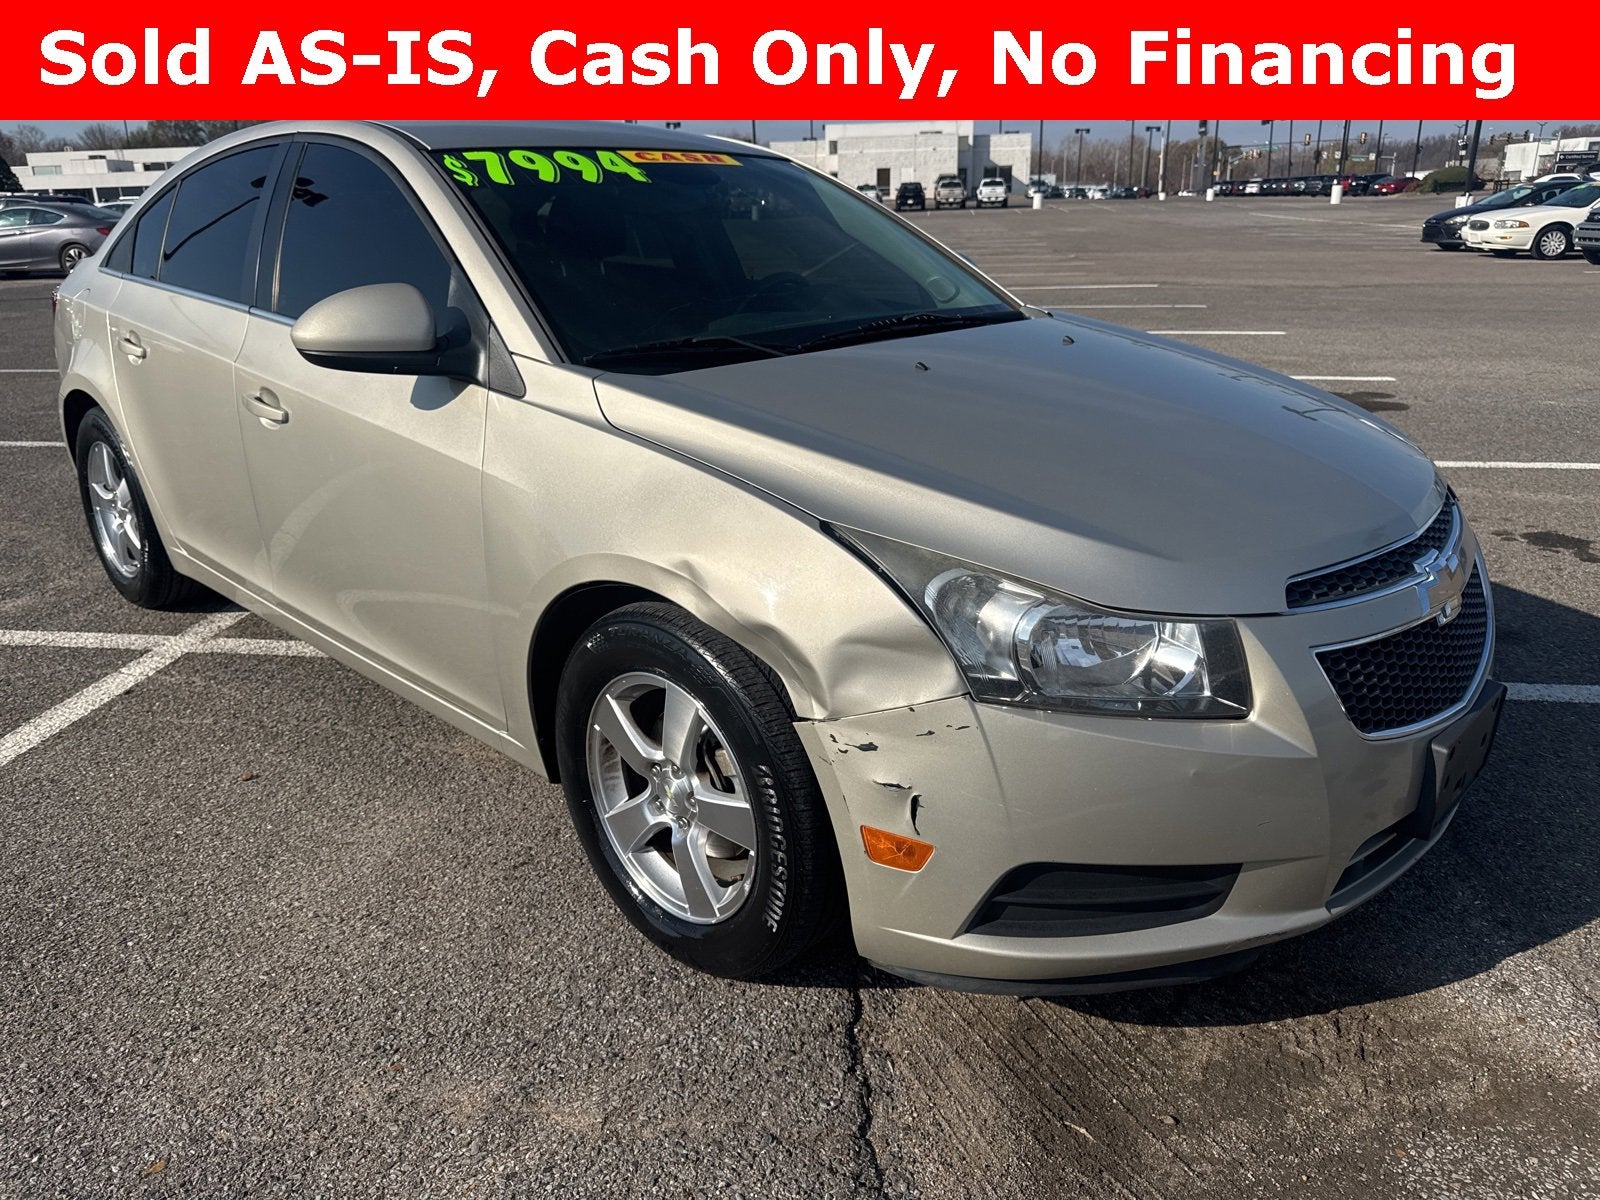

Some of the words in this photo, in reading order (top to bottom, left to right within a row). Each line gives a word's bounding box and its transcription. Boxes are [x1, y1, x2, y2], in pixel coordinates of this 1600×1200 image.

[442, 149, 652, 187] $7994
[634, 151, 728, 163] CASH
[751, 764, 788, 934] BRIDGESTONE
